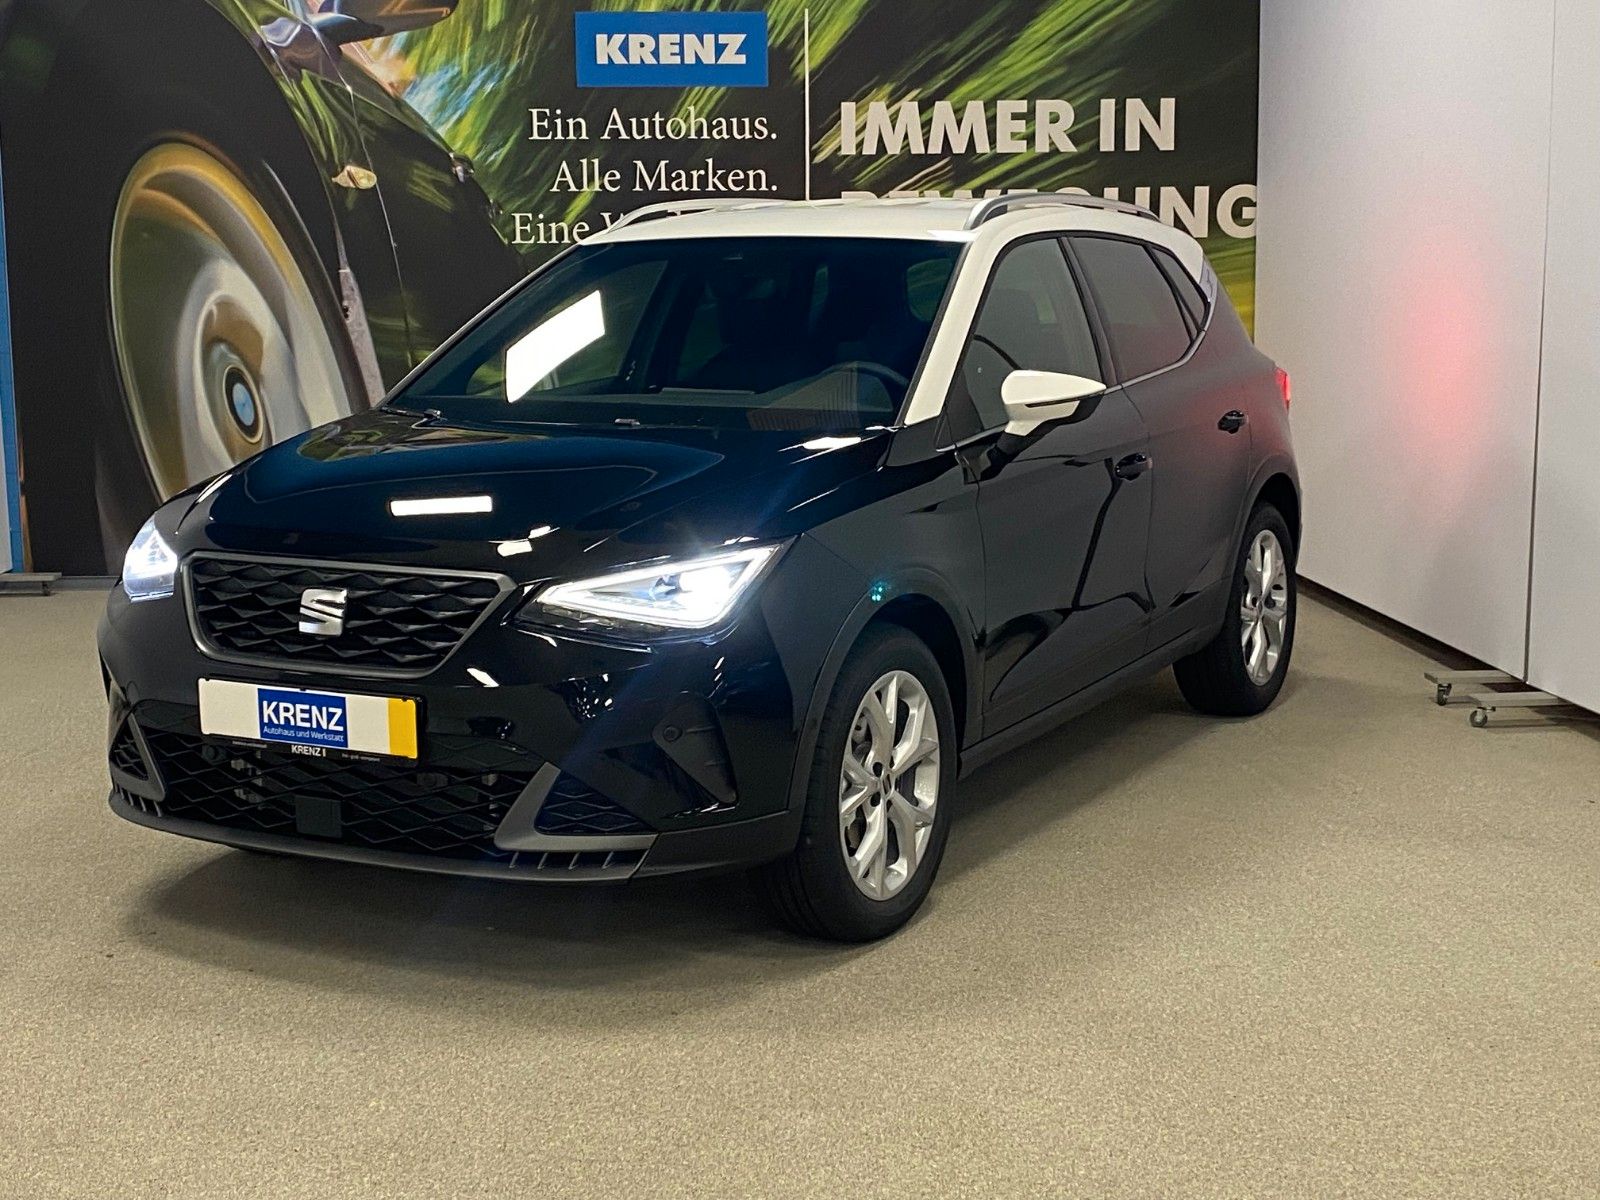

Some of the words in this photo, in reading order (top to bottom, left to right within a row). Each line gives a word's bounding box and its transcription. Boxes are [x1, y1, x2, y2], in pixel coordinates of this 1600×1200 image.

[595, 33, 747, 65] KRENZ
[528, 107, 590, 140] Ein
[600, 106, 778, 140] Autohaus.
[840, 98, 1078, 155] IMMER
[1099, 97, 1176, 152] IN
[549, 157, 622, 192] Alle
[631, 157, 778, 192] Marken.
[511, 212, 590, 244] Eine
[262, 700, 344, 731] KRENZ
[263, 725, 296, 737] Autohaus
[295, 730, 310, 739] und
[291, 744, 321, 757] KRENZ
